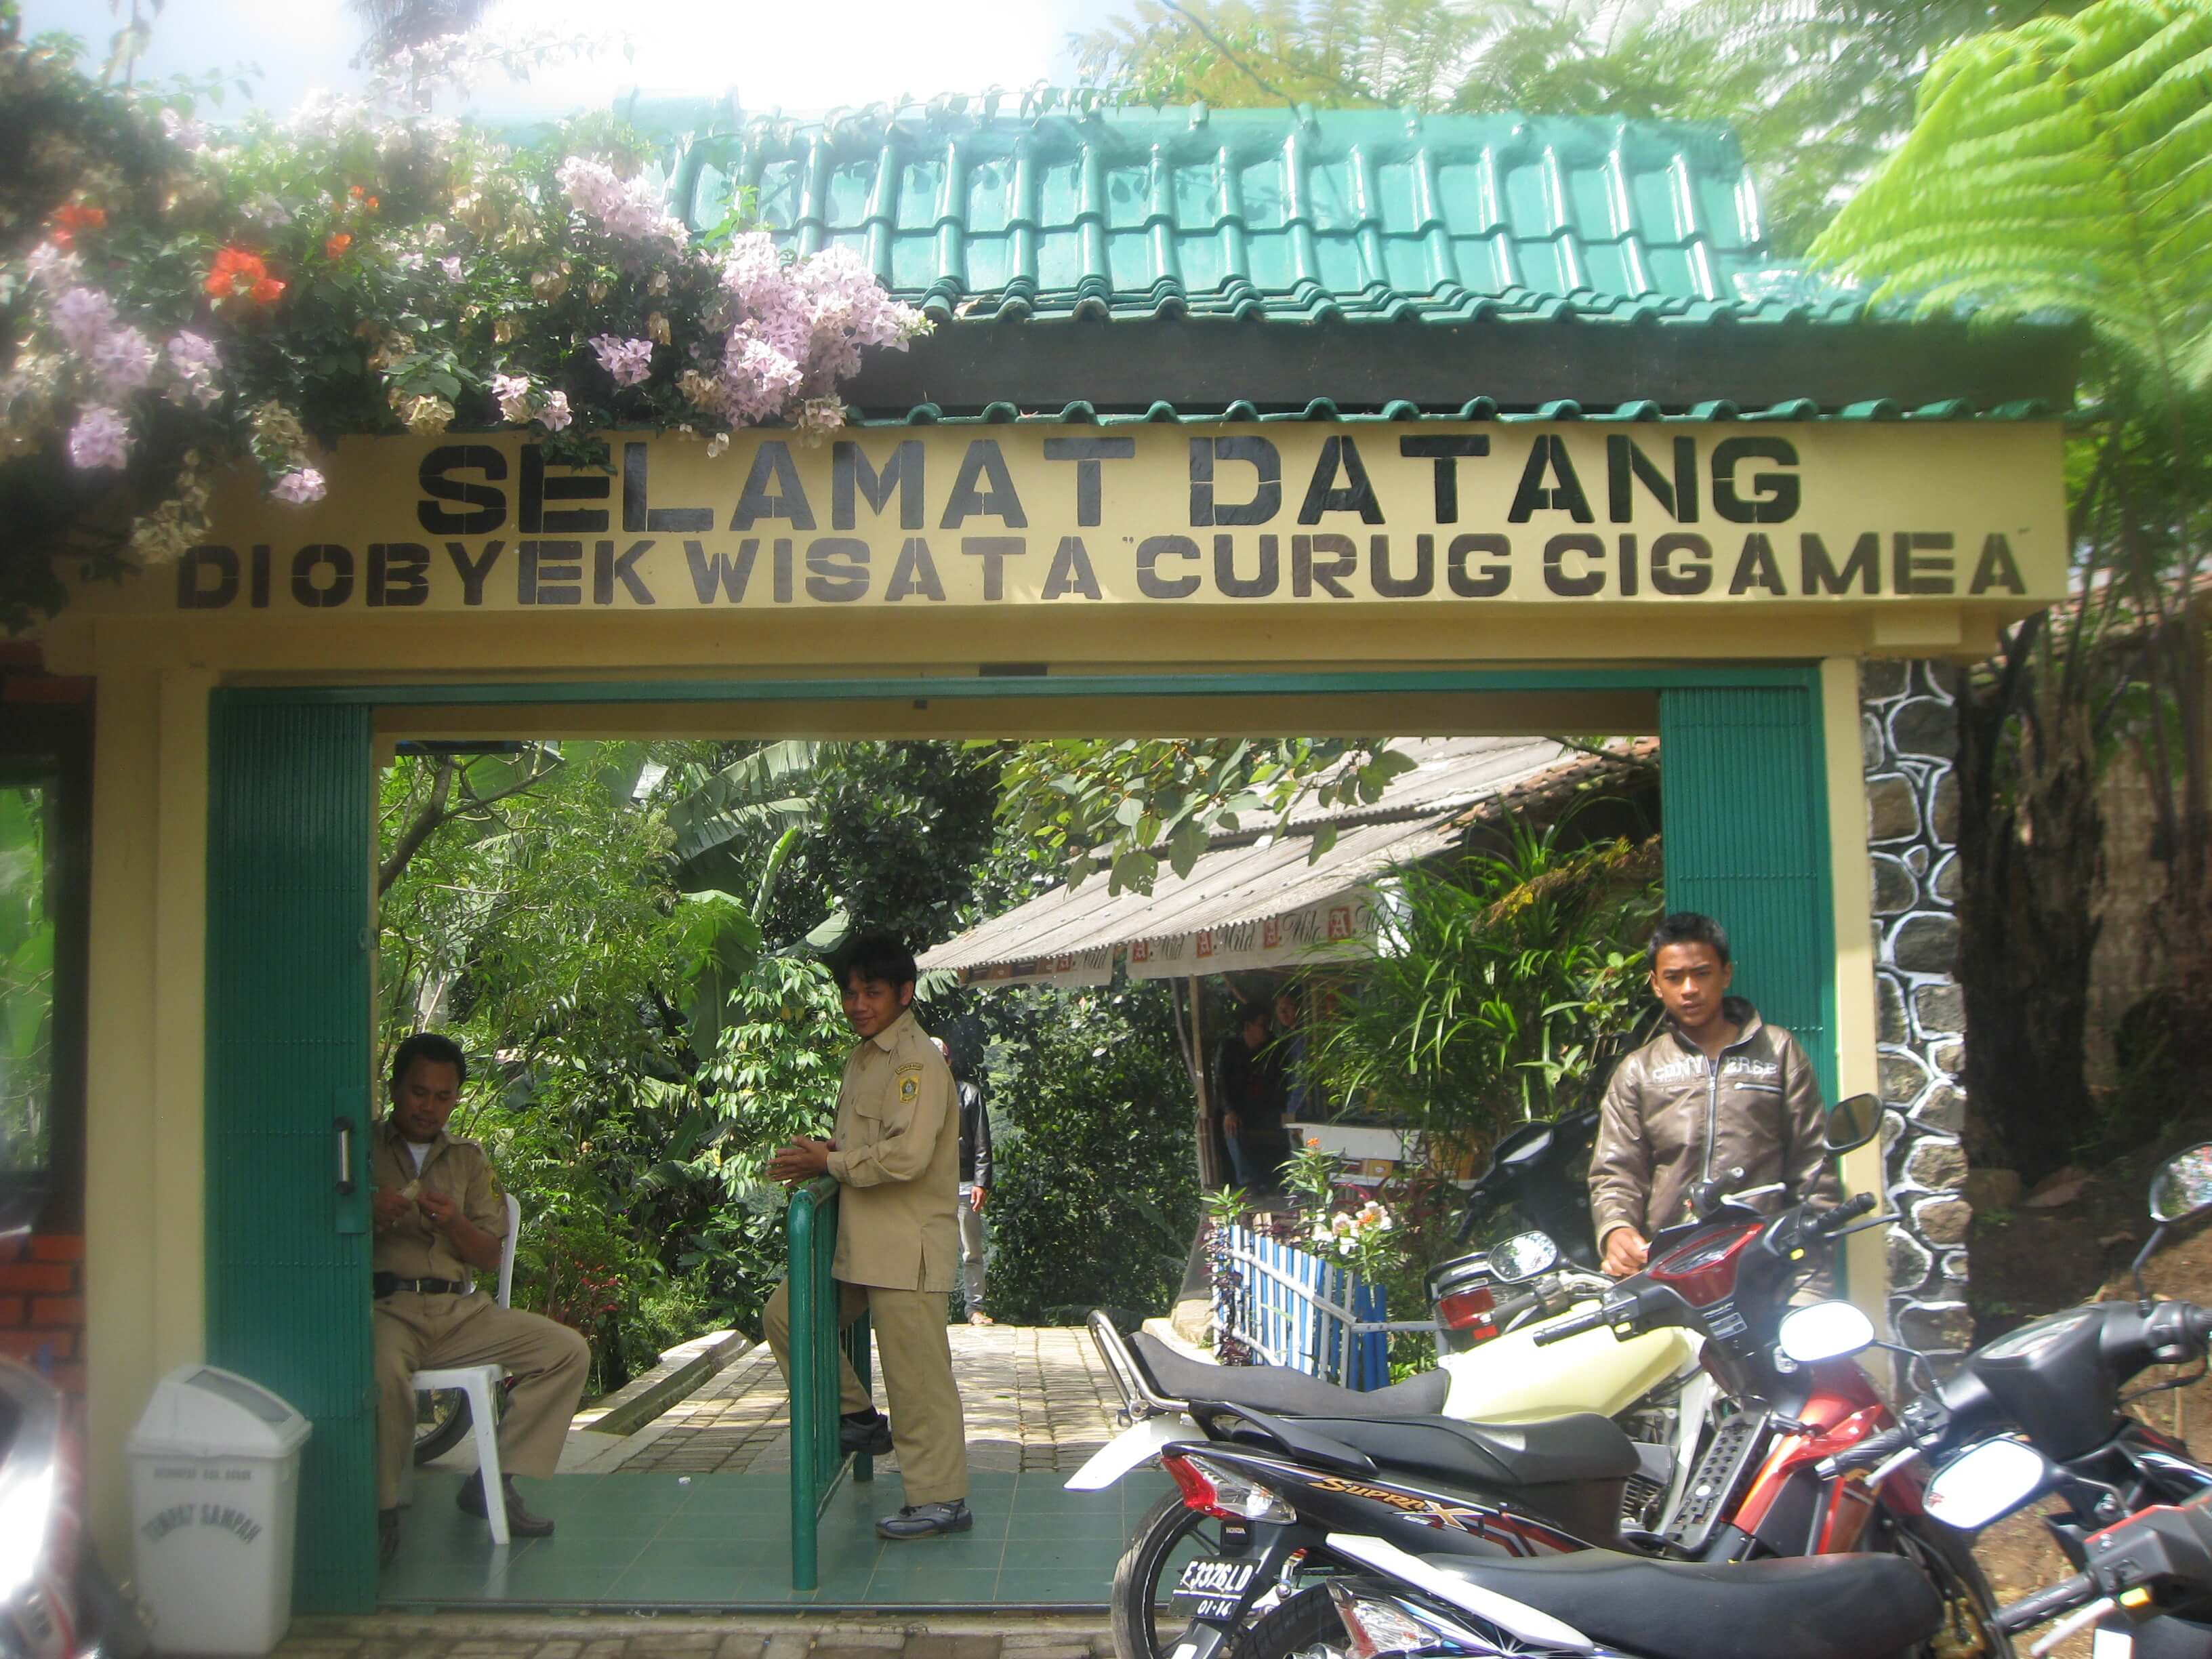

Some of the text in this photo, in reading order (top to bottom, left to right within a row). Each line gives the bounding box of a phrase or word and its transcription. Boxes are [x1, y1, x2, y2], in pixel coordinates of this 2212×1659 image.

[417, 434, 1801, 535] SELAMAT DATANG
[684, 535, 1103, 603] WISATA
